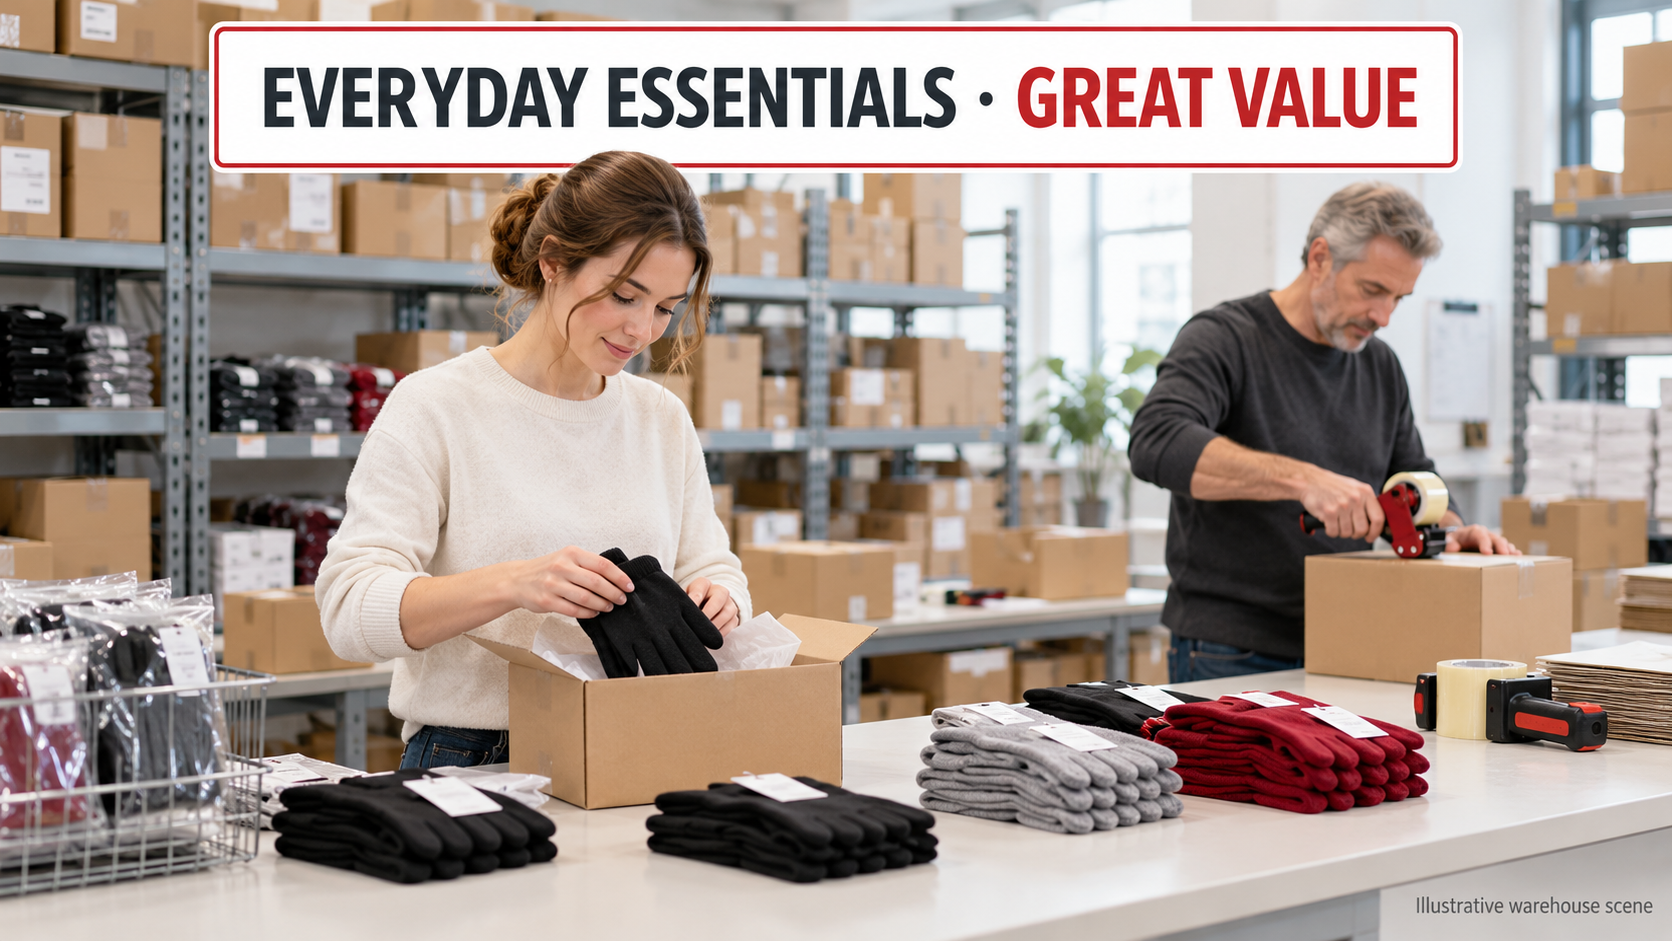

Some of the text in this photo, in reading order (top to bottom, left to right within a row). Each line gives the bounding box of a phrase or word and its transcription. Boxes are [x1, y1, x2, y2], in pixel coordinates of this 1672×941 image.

[263, 67, 589, 128] EVERYDAY
[608, 66, 957, 129] ESSENTIALS
[1017, 66, 1214, 129] GREAT
[1227, 67, 1418, 129] VALUE
